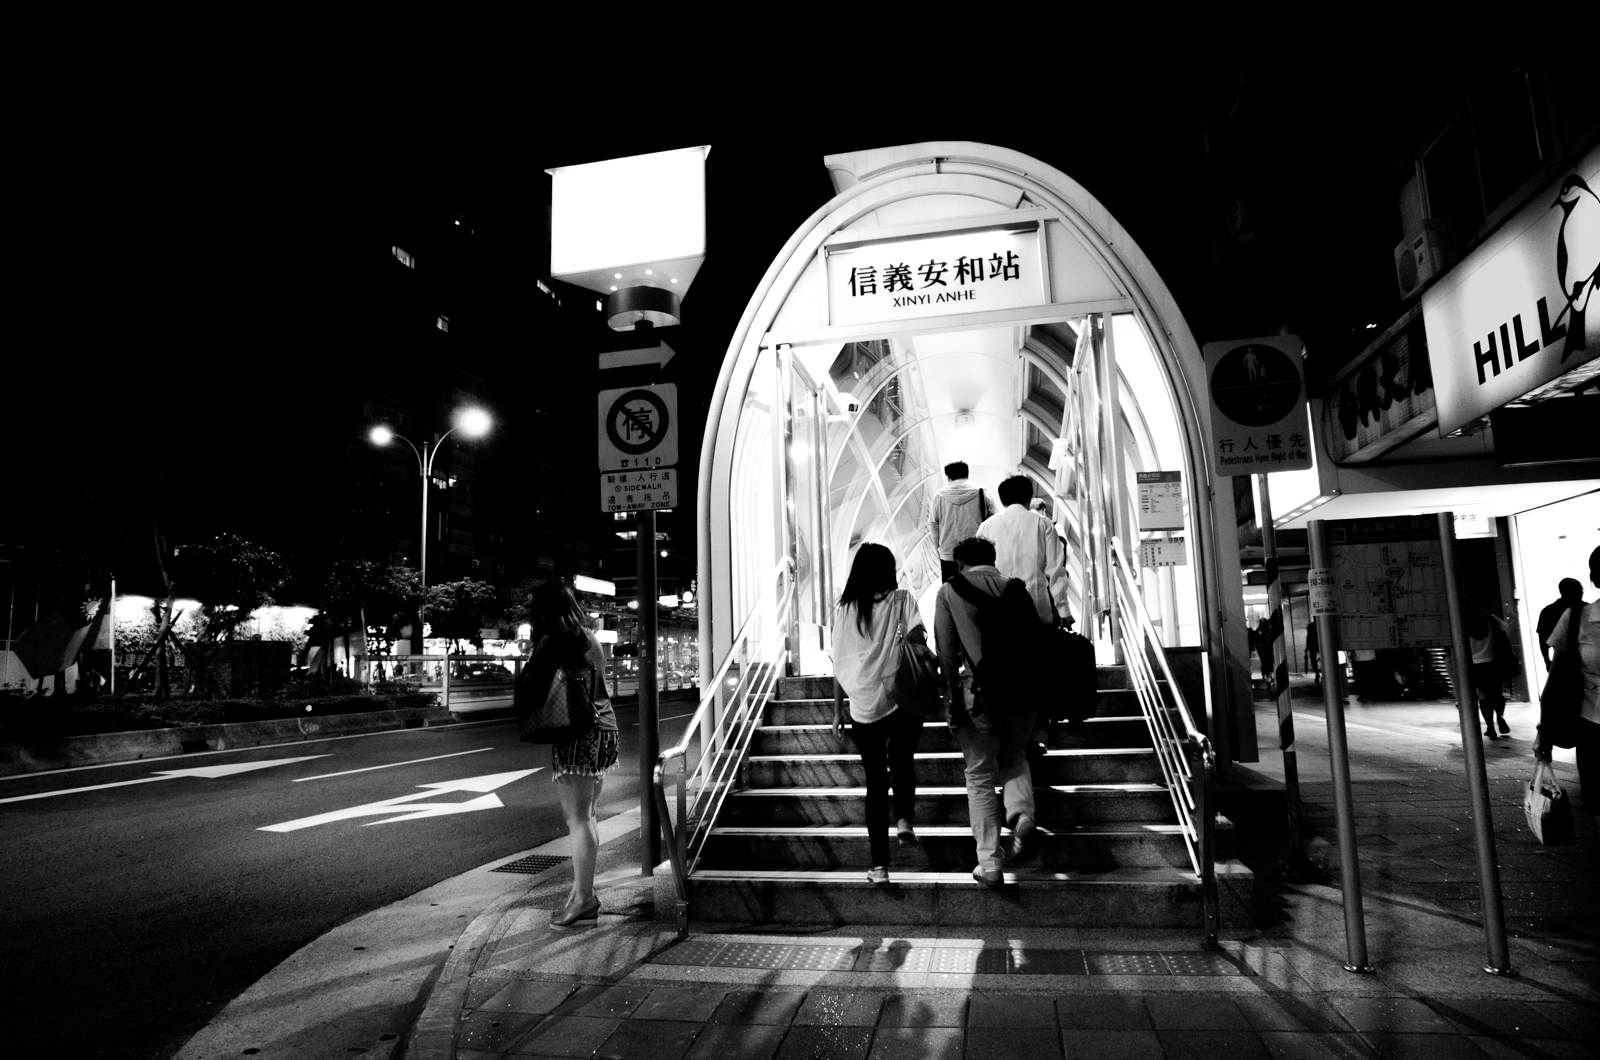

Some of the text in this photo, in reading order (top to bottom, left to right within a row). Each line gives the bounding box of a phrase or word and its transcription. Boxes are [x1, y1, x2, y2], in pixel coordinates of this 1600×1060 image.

[847, 250, 1020, 297] 信義安和站
[893, 289, 976, 307] XINYI ANHE
[622, 407, 652, 440] 停
[1219, 432, 1306, 453] 行人優先
[634, 456, 661, 467] 110
[1220, 450, 1307, 465] Pedestrians Have Right of Way
[624, 483, 662, 491] SIDEWALK
[607, 491, 670, 504] 違者拖吊
[608, 502, 646, 511] TOW-AWAY
